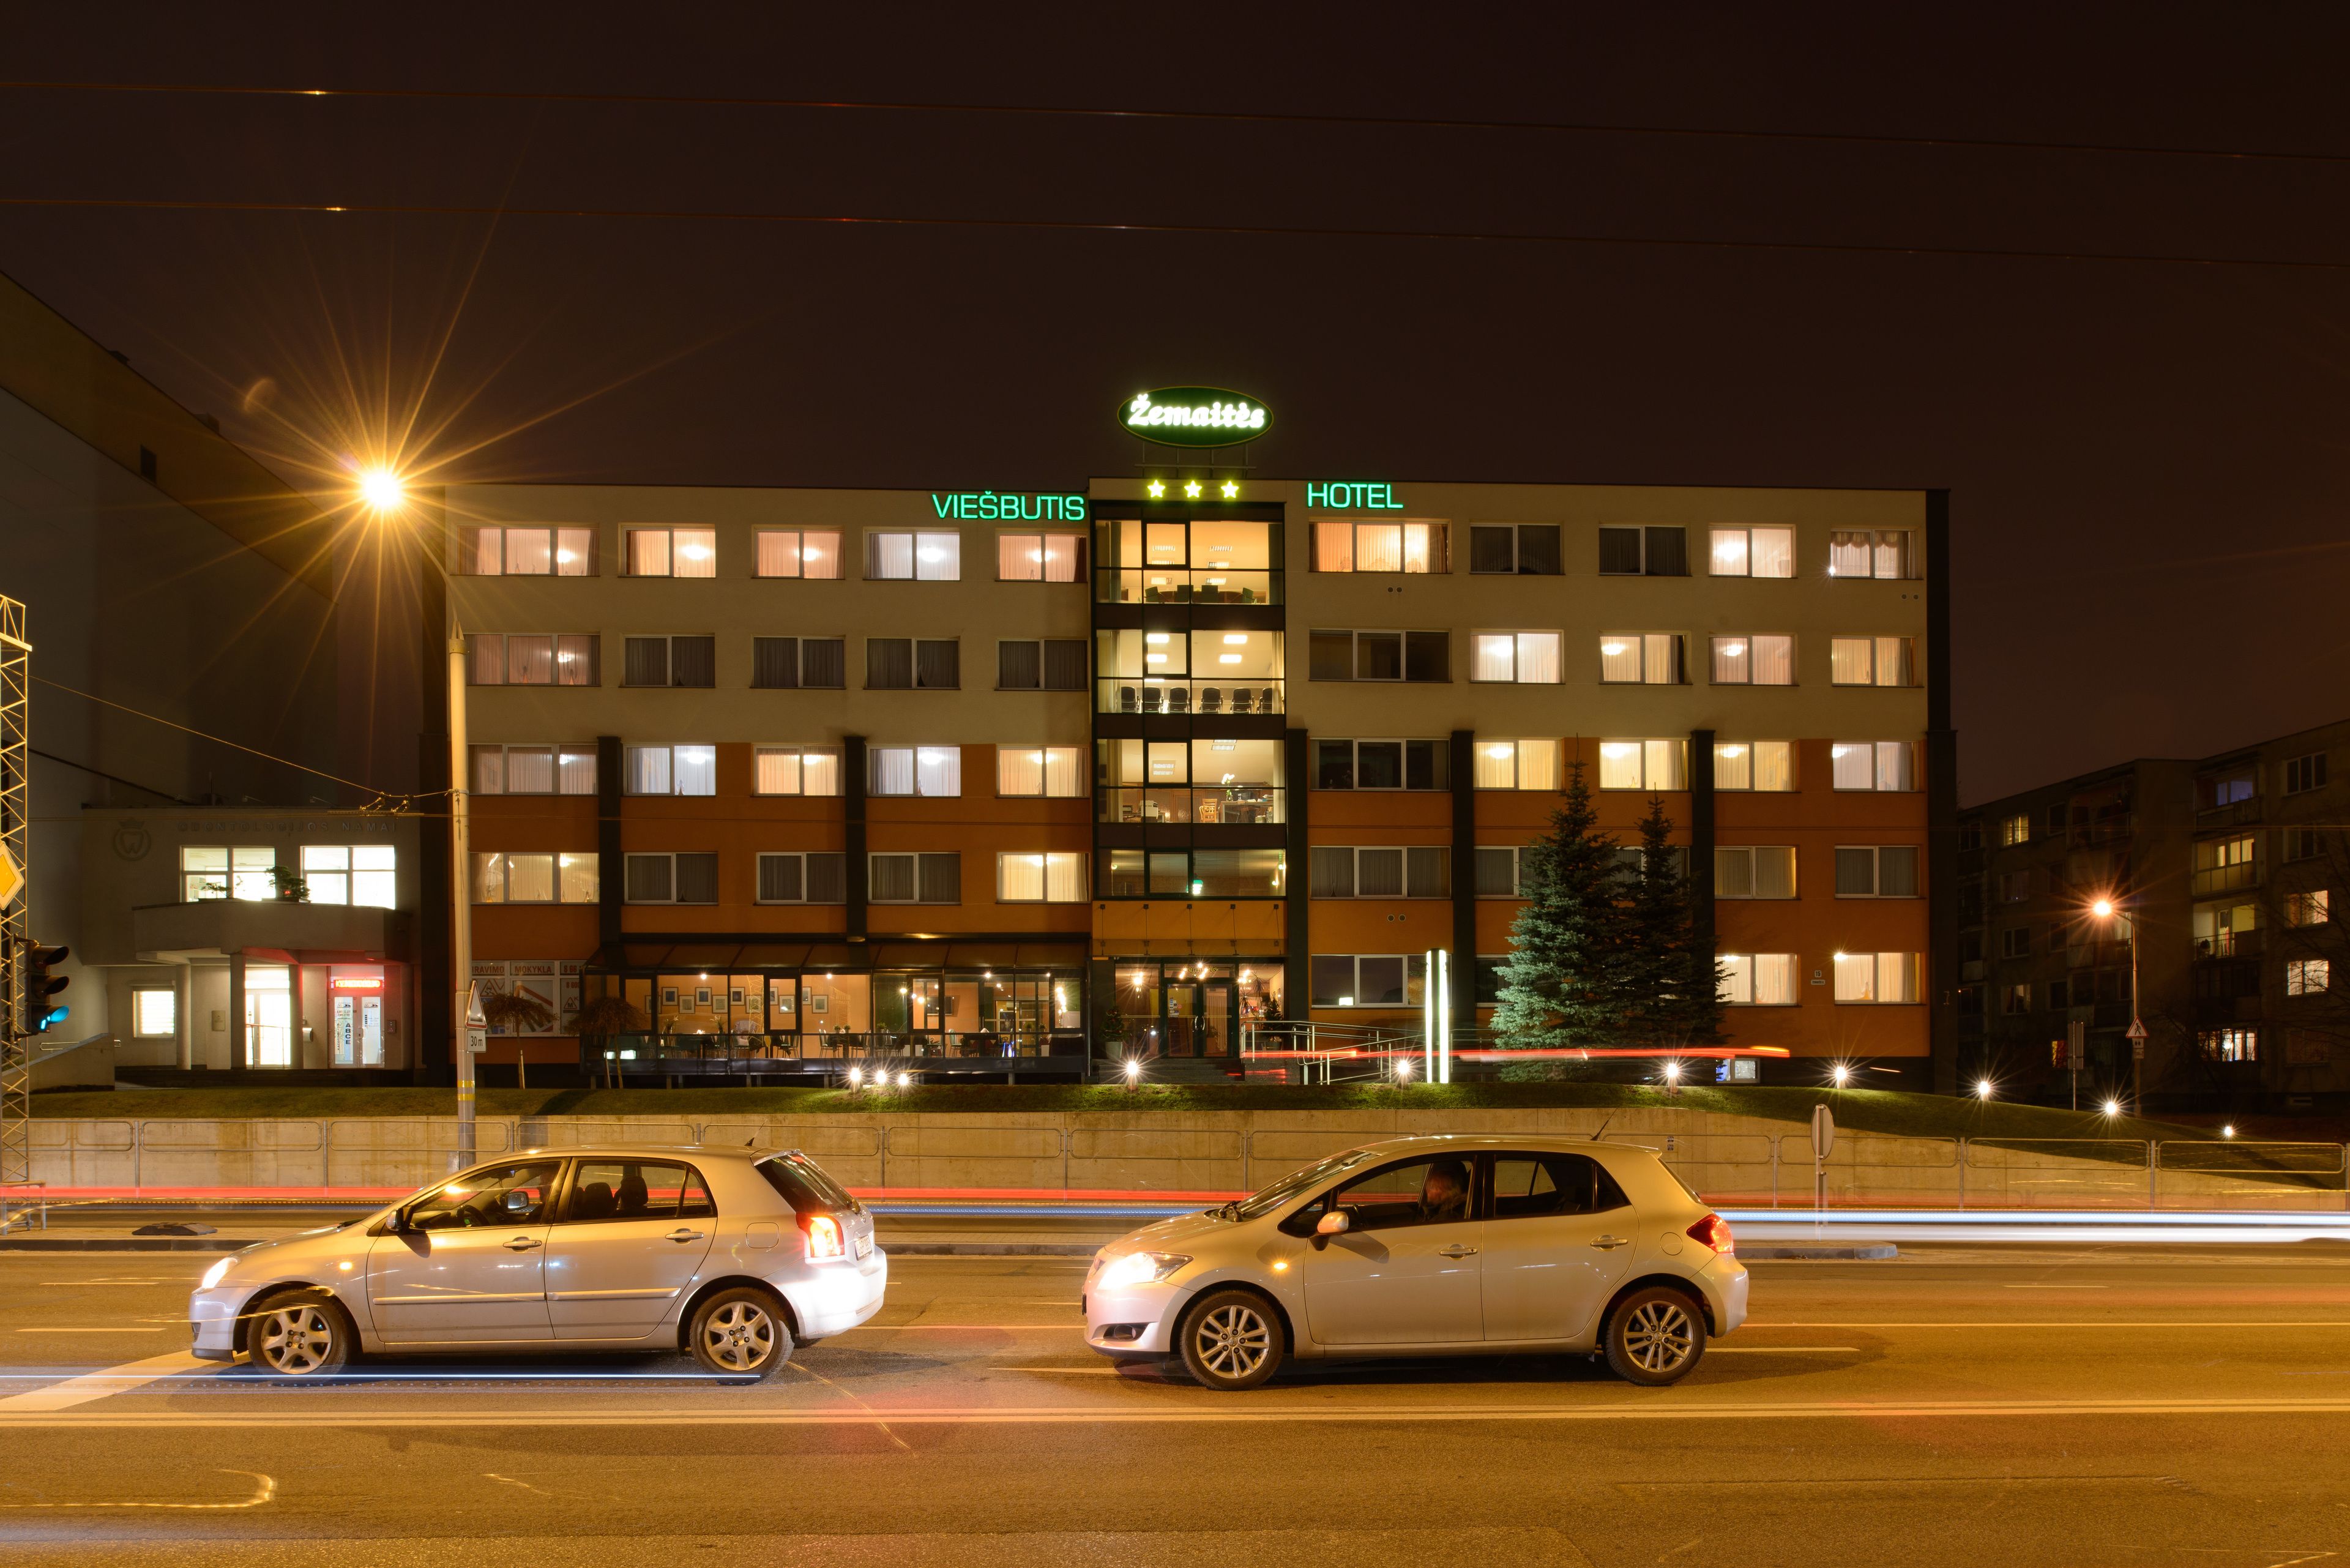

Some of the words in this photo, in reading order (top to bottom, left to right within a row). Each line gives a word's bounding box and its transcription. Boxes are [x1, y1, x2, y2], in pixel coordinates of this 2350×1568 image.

[1128, 393, 1265, 429] Žemaitės
[1307, 482, 1404, 509] HOTEL
[931, 490, 1086, 521] VIEŠBUTIS
[342, 821, 397, 832] NAMAI
[515, 965, 552, 974] MOKYKLA
[471, 1036, 477, 1047] 30
